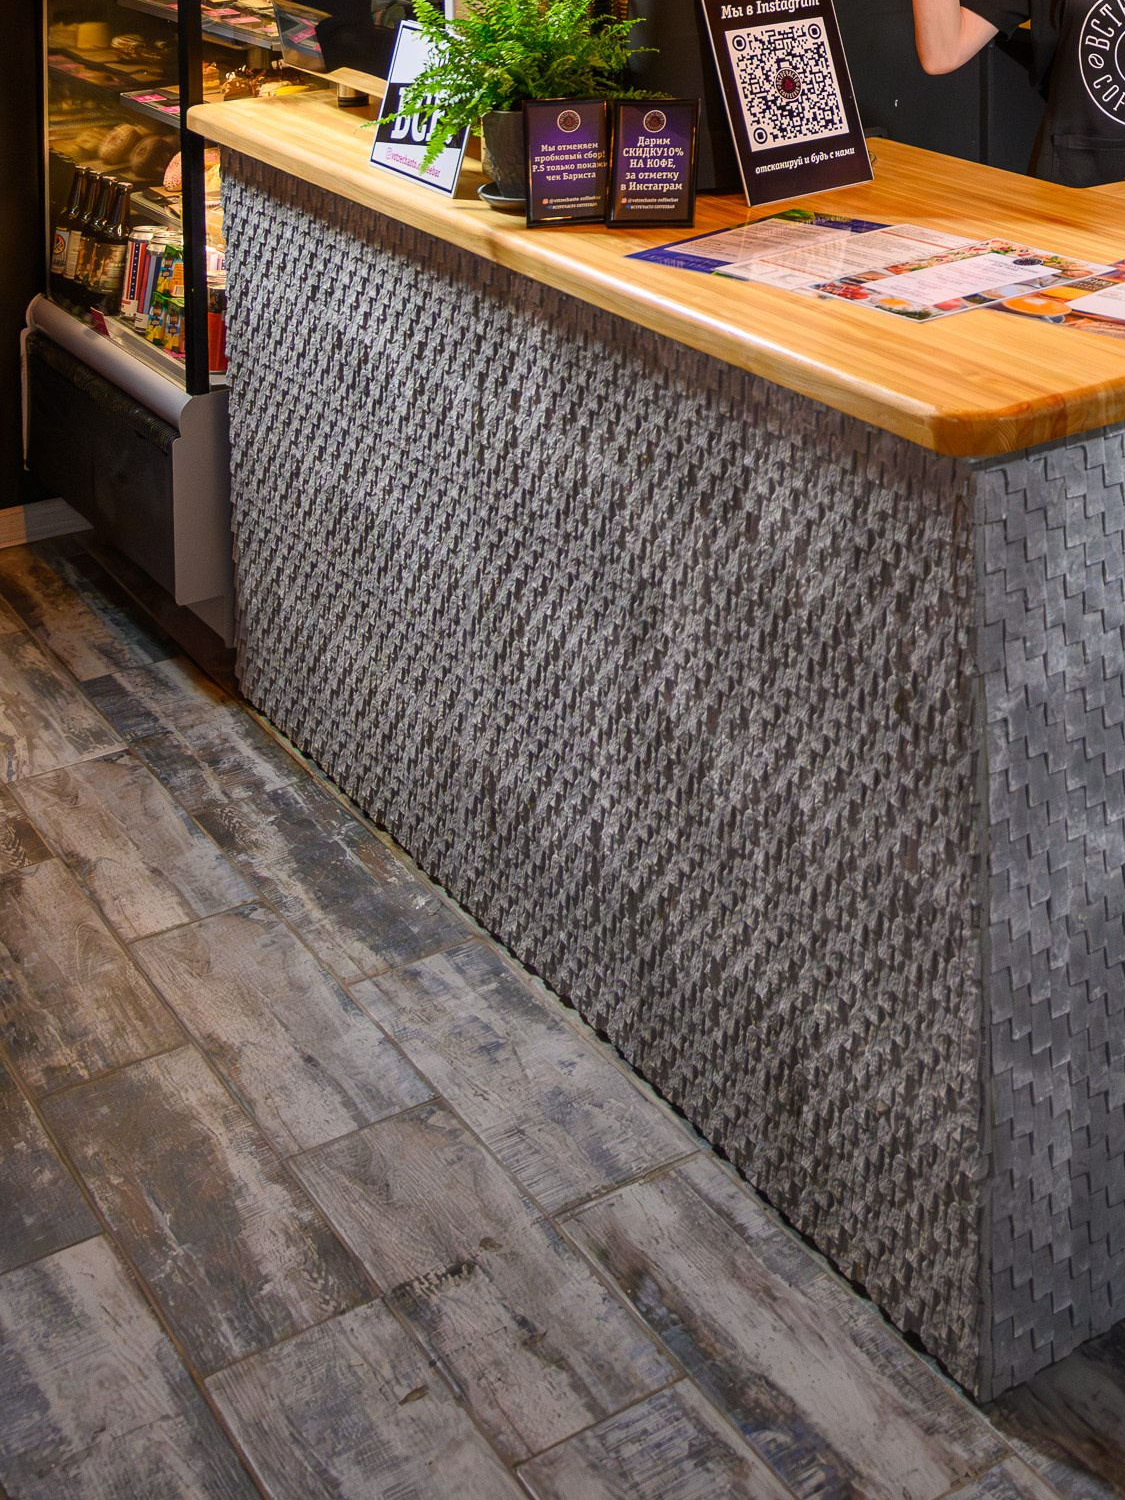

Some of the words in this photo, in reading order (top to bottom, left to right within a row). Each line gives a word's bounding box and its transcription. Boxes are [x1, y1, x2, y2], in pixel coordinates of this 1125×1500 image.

[721, 5, 743, 19] Мы
[747, 4, 753, 15] в
[638, 137, 671, 146] Дарим
[558, 143, 598, 151] отменяем
[535, 153, 581, 162] пробковый
[755, 157, 803, 174] отсканируй
[811, 152, 828, 164] будь
[835, 147, 855, 156] нами
[630, 159, 644, 168] НА
[646, 159, 676, 169] КОФЕ,
[563, 172, 596, 180] Бариста
[638, 172, 679, 181] отметку
[629, 182, 682, 192] Инстаграм
